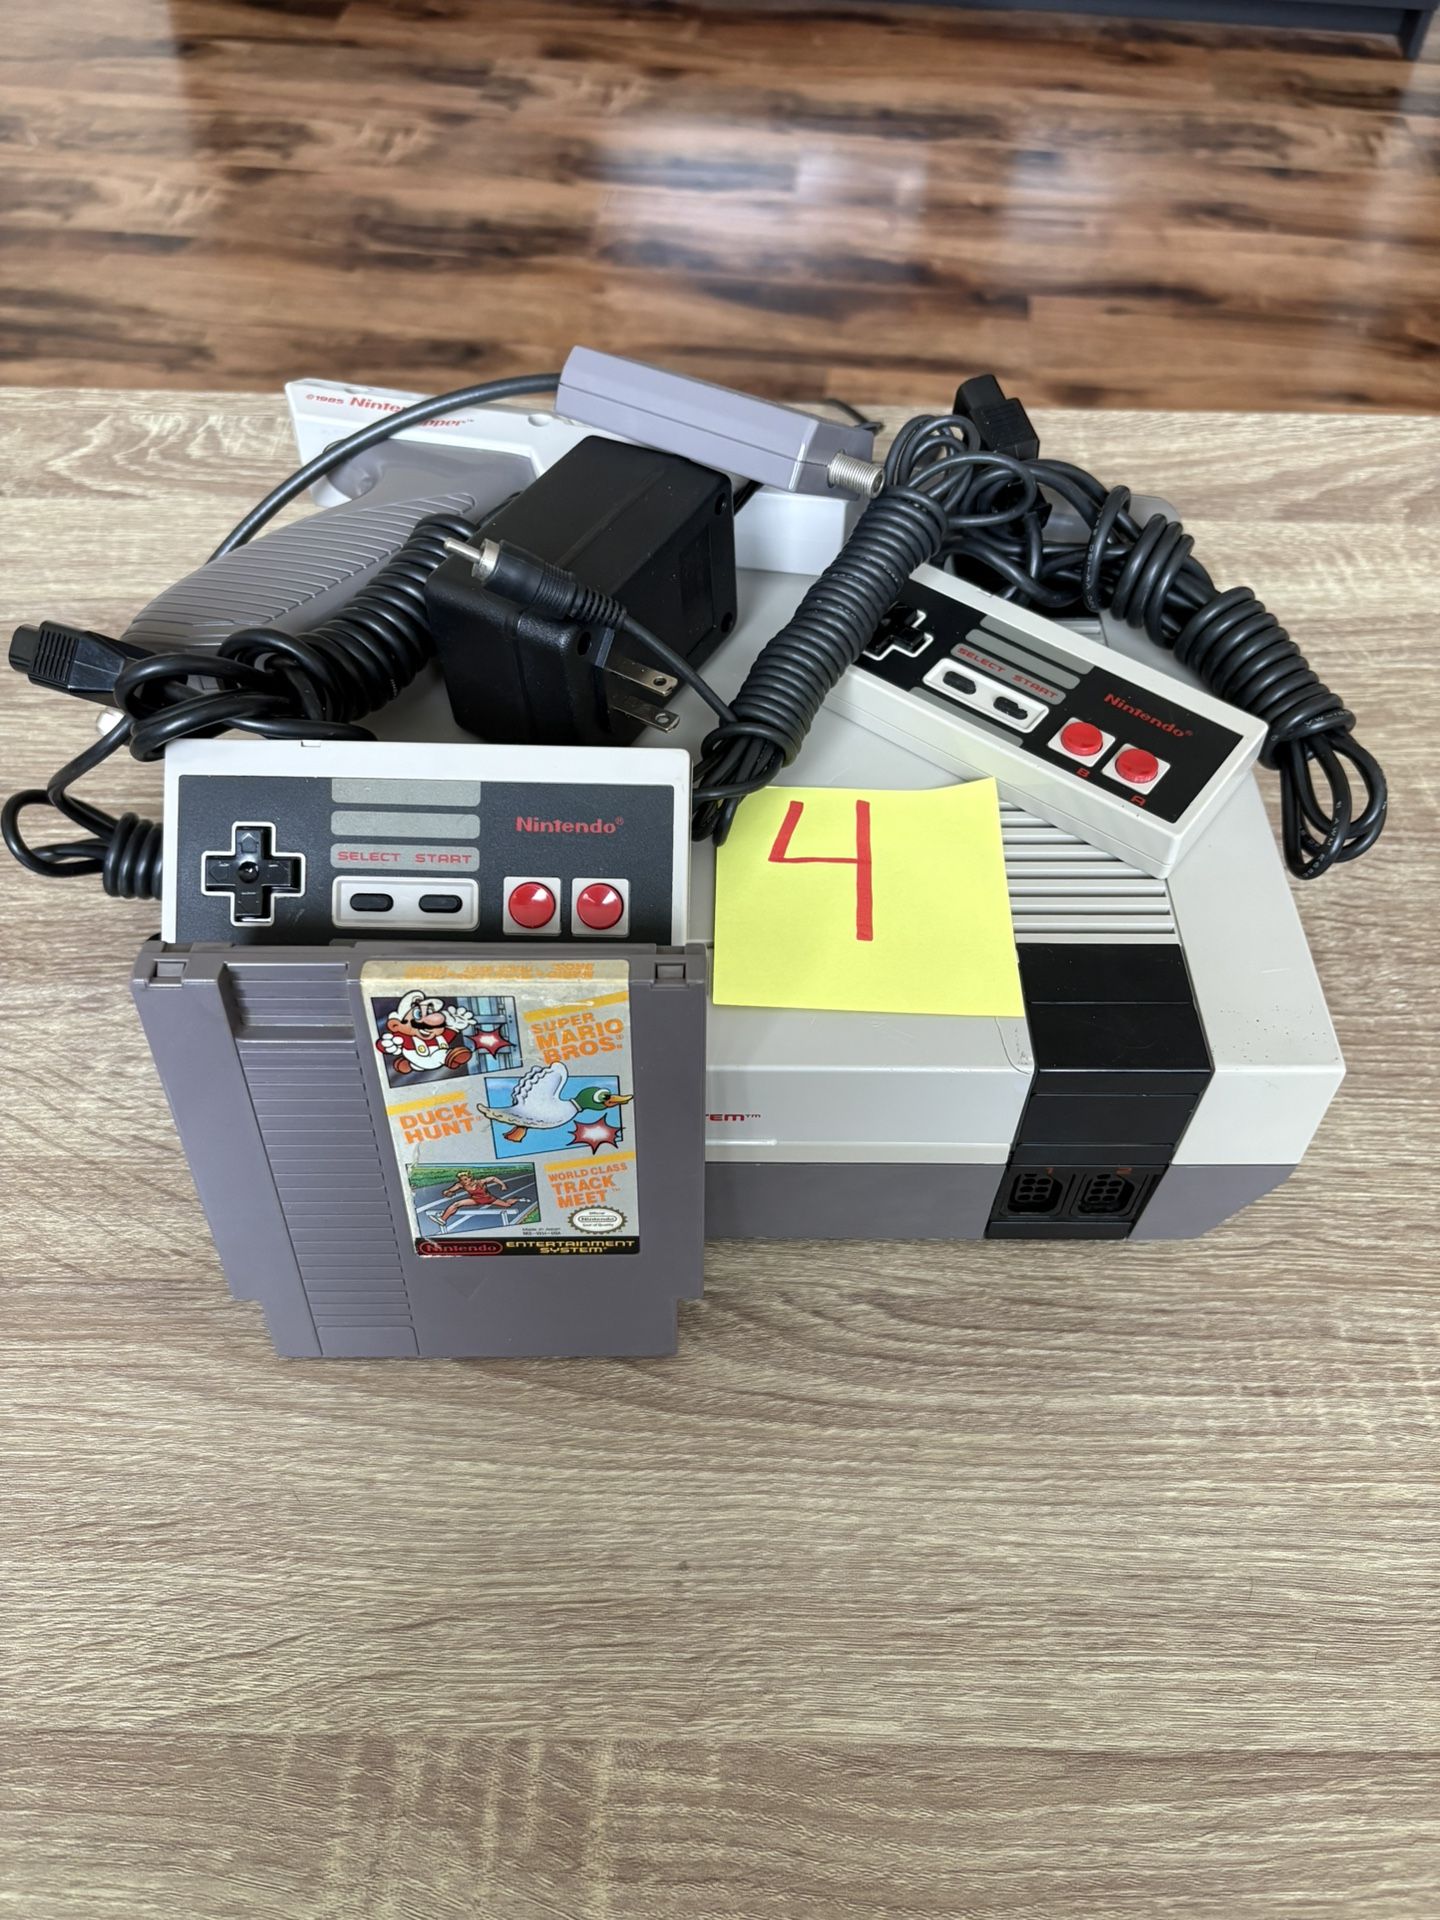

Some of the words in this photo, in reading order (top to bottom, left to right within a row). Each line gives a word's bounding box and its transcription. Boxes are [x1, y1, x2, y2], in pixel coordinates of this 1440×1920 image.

[350, 396, 407, 413] Ninte
[958, 647, 1005, 673] SELECT
[1012, 674, 1057, 698] START
[1076, 767, 1091, 778] B
[1131, 795, 1146, 807] A
[338, 851, 400, 862] SELECT
[415, 853, 472, 864] START
[768, 800, 873, 941] 4
[530, 1012, 595, 1034] SUPER
[535, 1018, 624, 1050] MARIO
[399, 1103, 473, 1129] DUCK
[547, 1168, 588, 1182] WORLD
[590, 1162, 628, 1175] CLASS
[551, 1174, 616, 1195] TRACK
[426, 1240, 497, 1252] Nintendo
